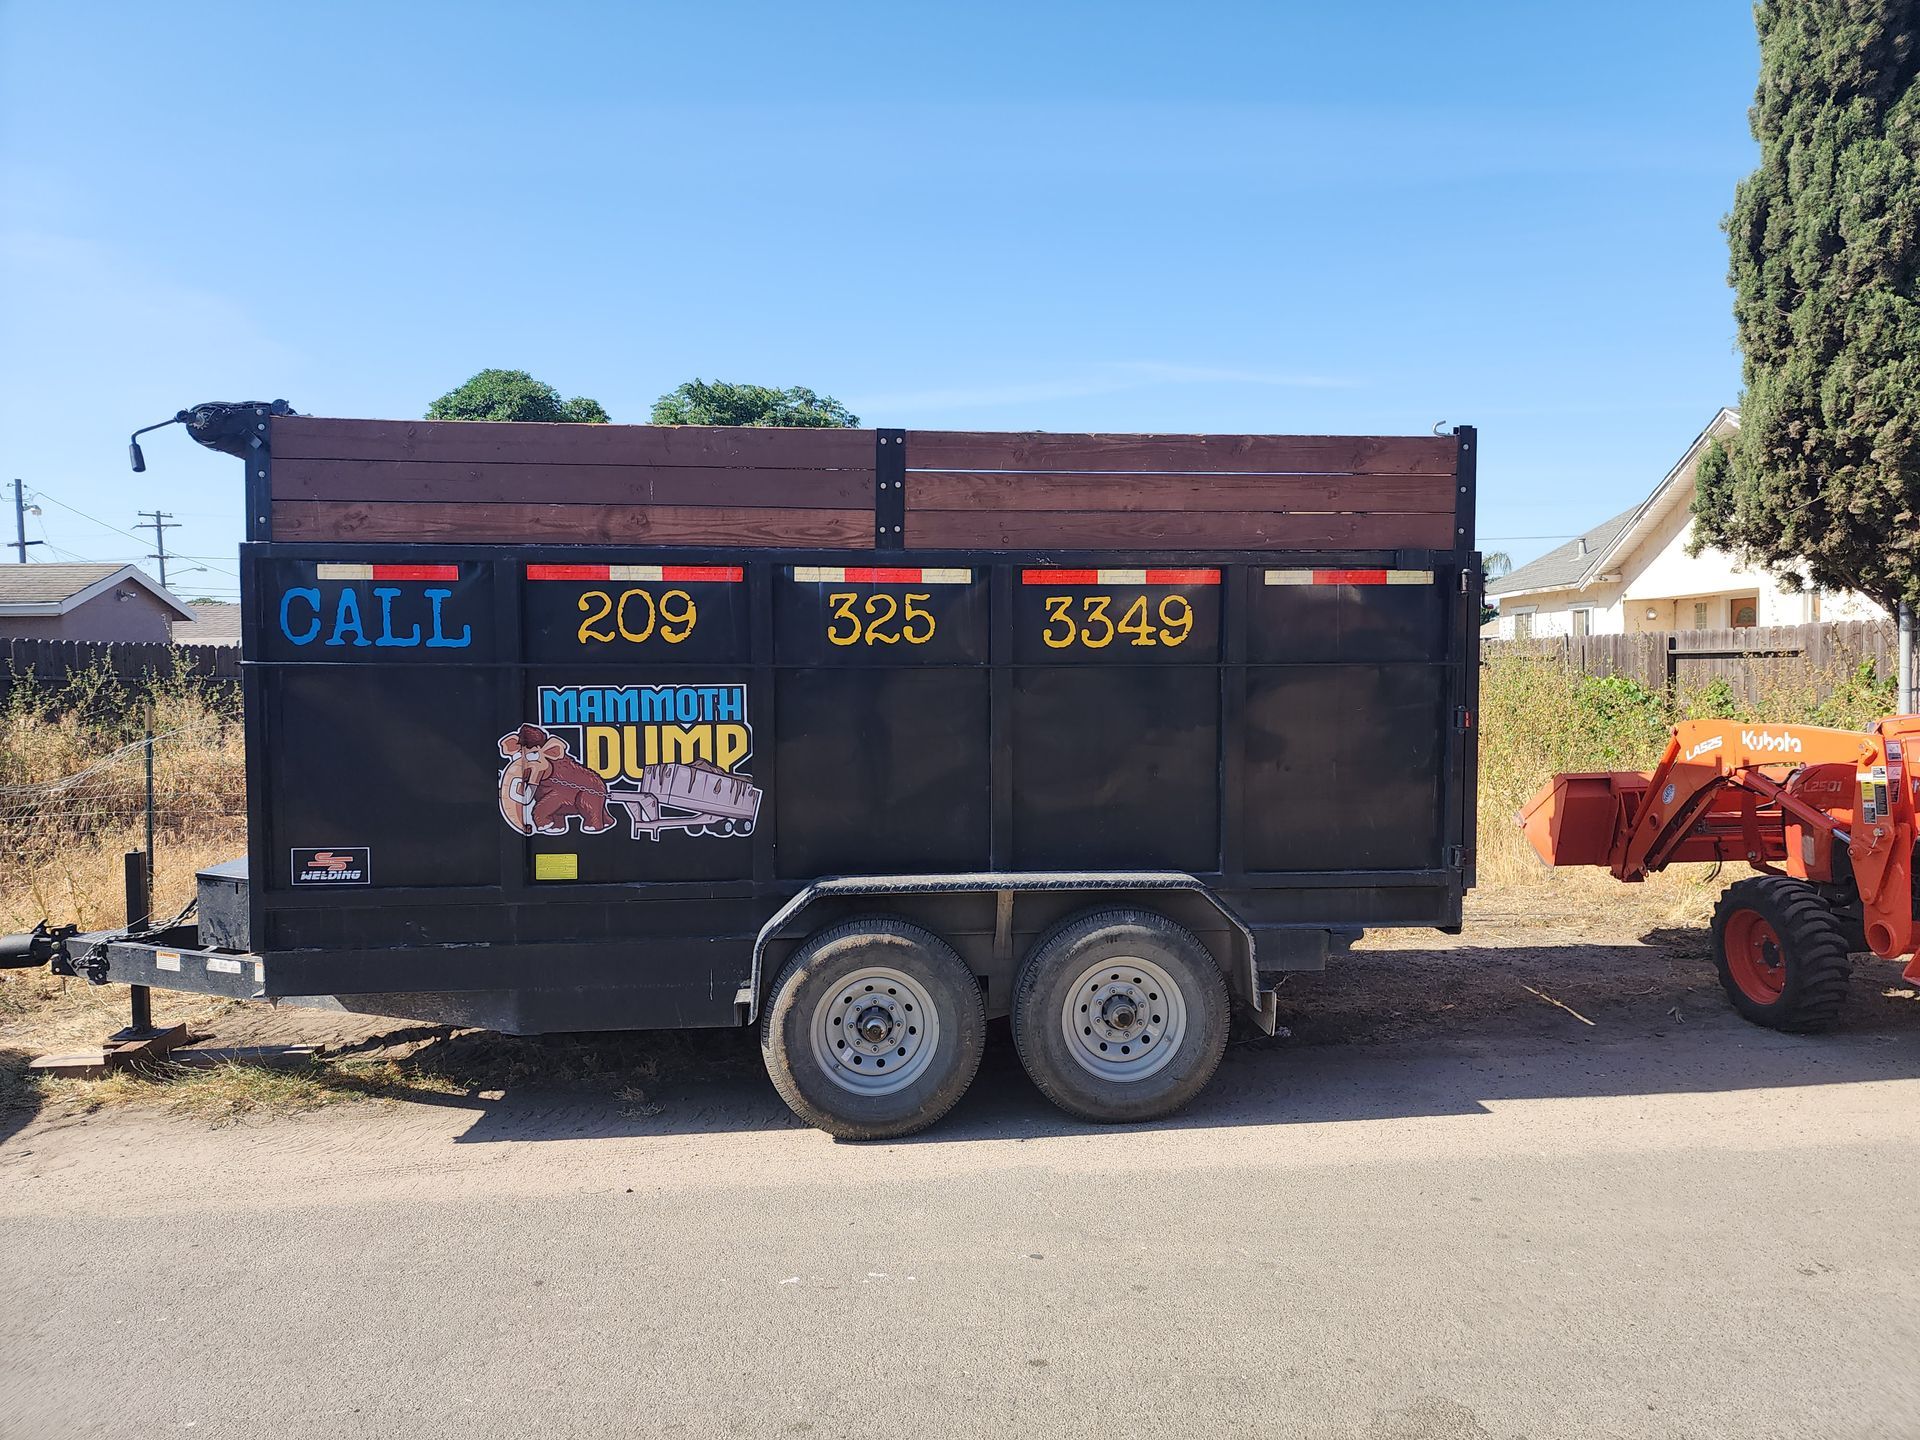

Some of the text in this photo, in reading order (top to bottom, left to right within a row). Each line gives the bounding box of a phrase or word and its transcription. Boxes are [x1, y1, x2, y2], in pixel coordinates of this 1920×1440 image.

[280, 587, 1194, 648] CALL 209 325 3349
[543, 688, 743, 723] MAMMOTH
[586, 723, 749, 780] DUMP
[1741, 730, 1802, 753] Kubota
[300, 870, 361, 881] WELDING
